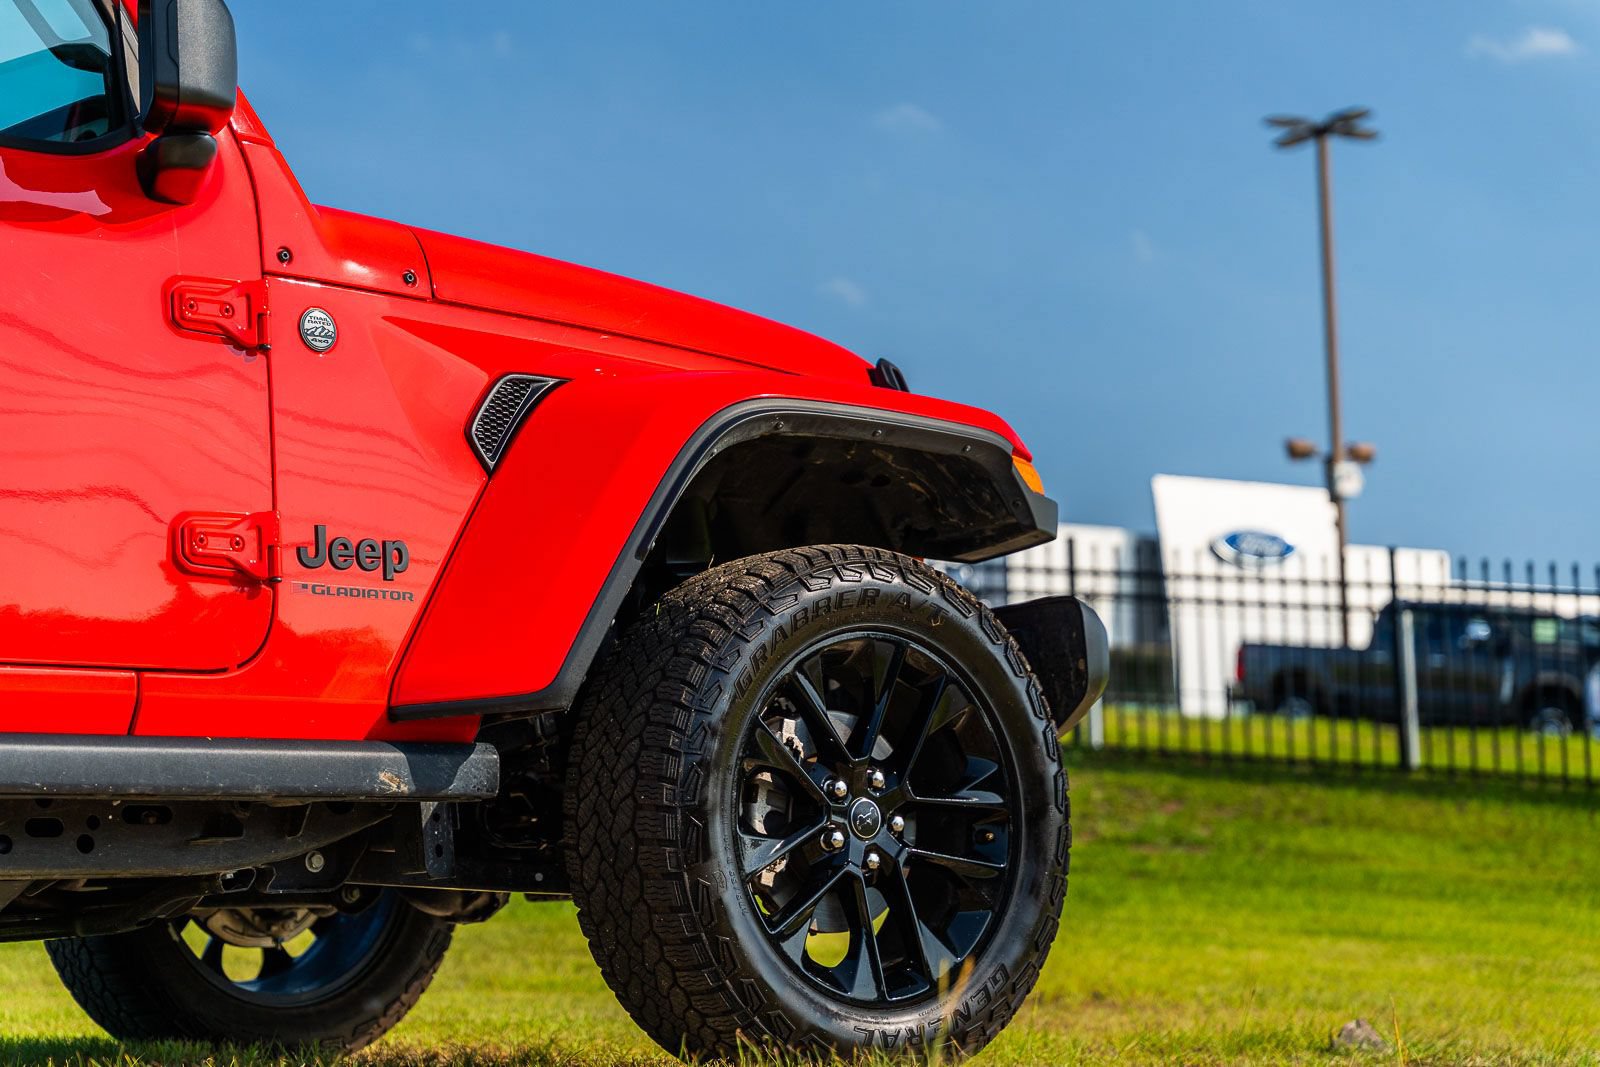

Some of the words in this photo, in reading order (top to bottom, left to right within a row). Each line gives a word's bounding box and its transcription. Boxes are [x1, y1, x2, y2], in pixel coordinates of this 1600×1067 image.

[295, 524, 410, 581] Jeep
[310, 583, 415, 602] GLADIATOR
[734, 587, 881, 700] GRABBER
